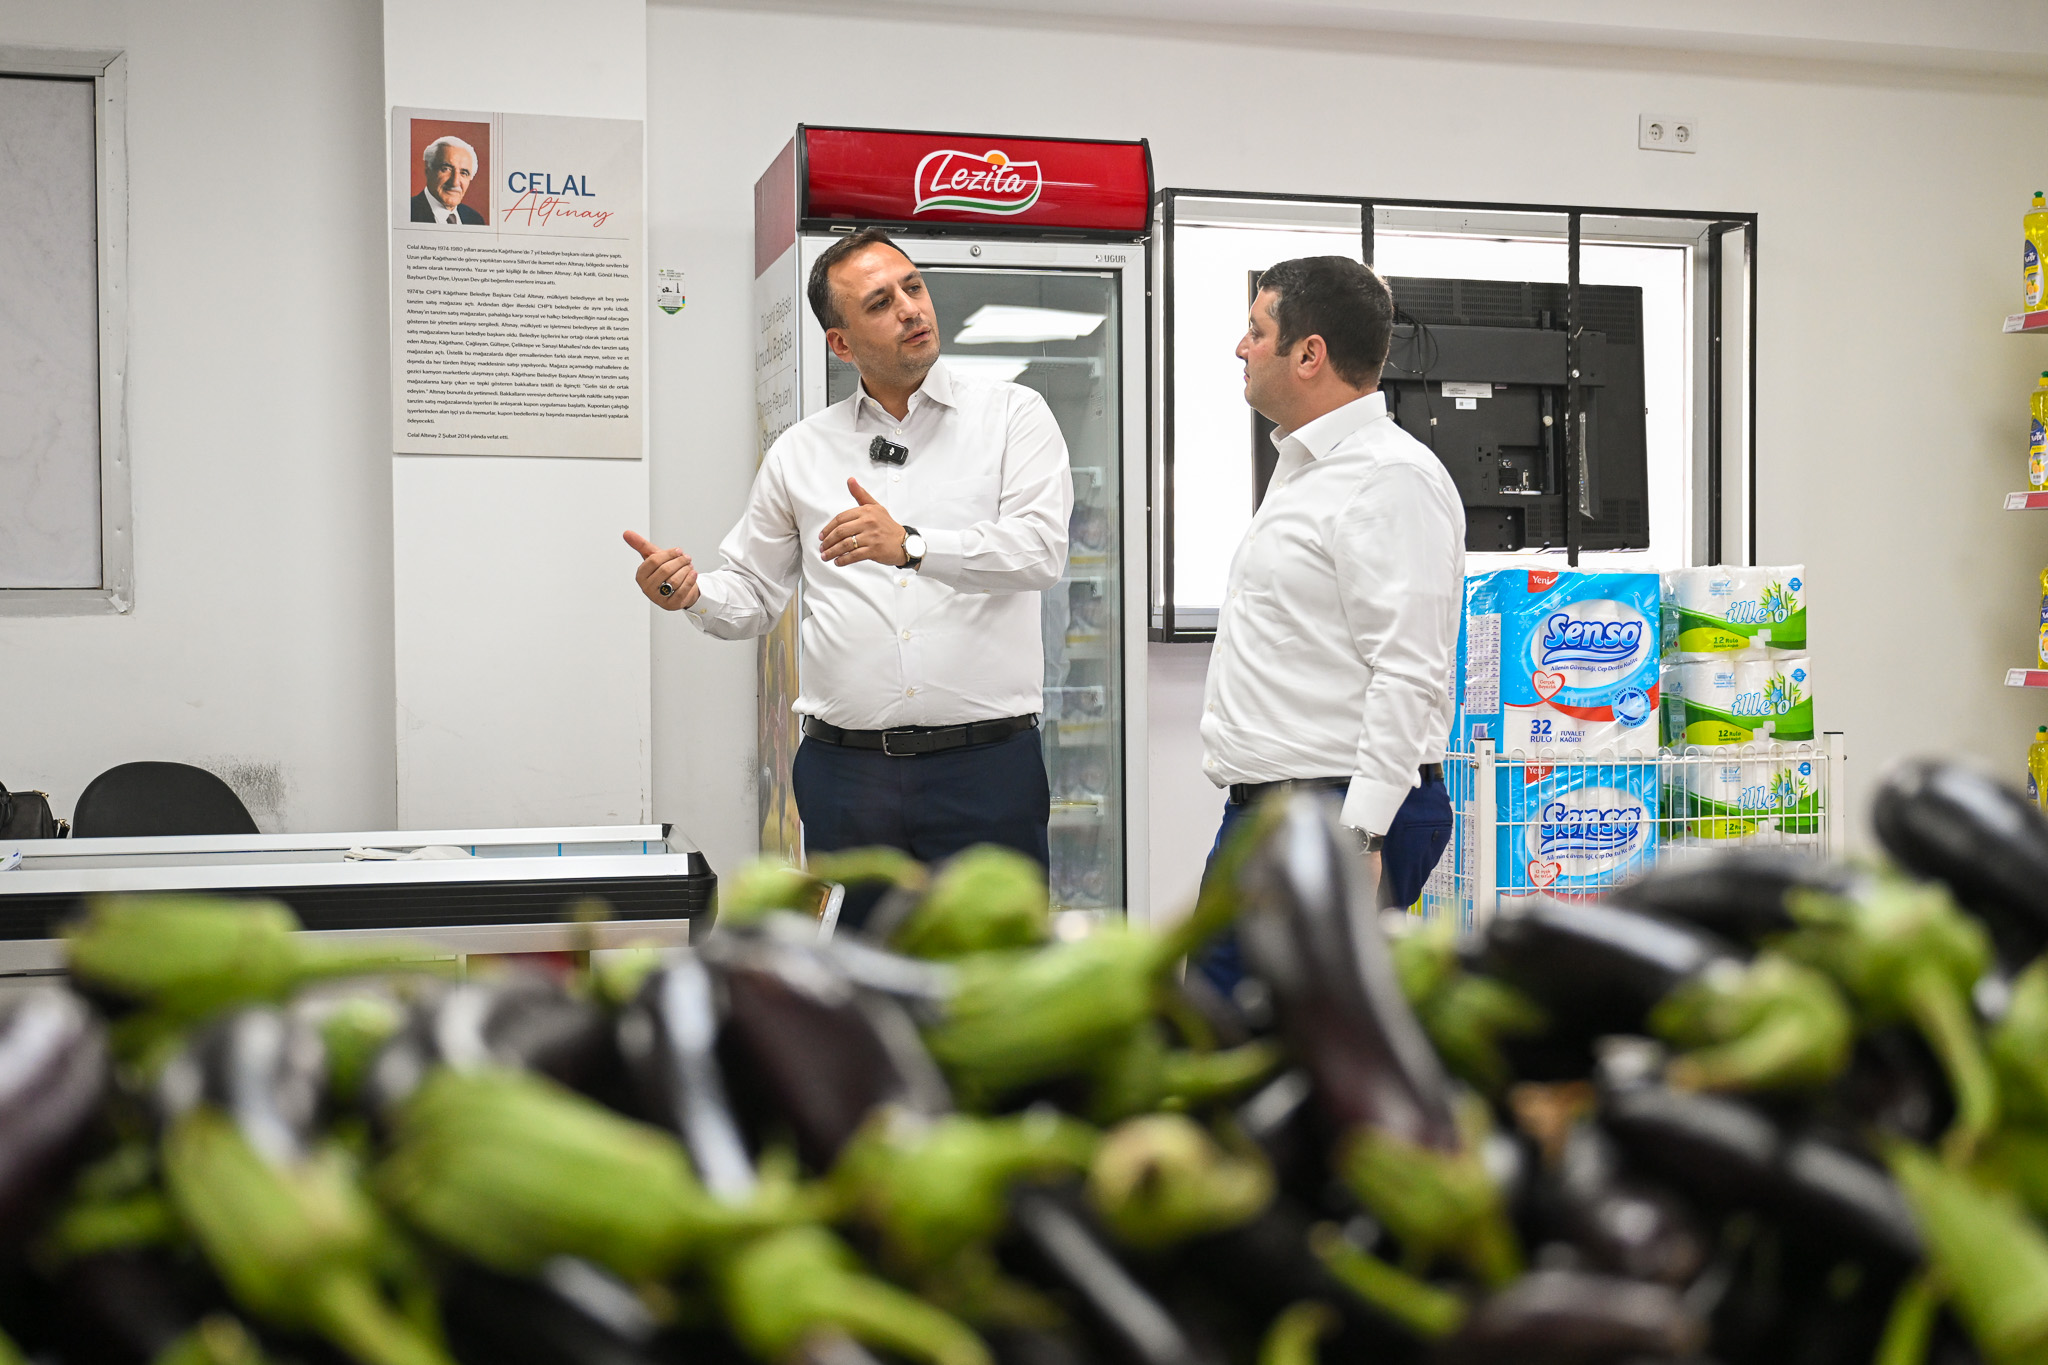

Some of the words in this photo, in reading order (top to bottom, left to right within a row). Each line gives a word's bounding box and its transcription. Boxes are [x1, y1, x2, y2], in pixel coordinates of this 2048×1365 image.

[509, 171, 595, 196] CELAL
[930, 153, 1026, 193] Lezita
[502, 189, 614, 227] Altınay
[1533, 576, 1549, 584] Yeni
[1544, 614, 1641, 648] Senso
[1598, 664, 1607, 672] Cep
[1531, 720, 1551, 734] 32
